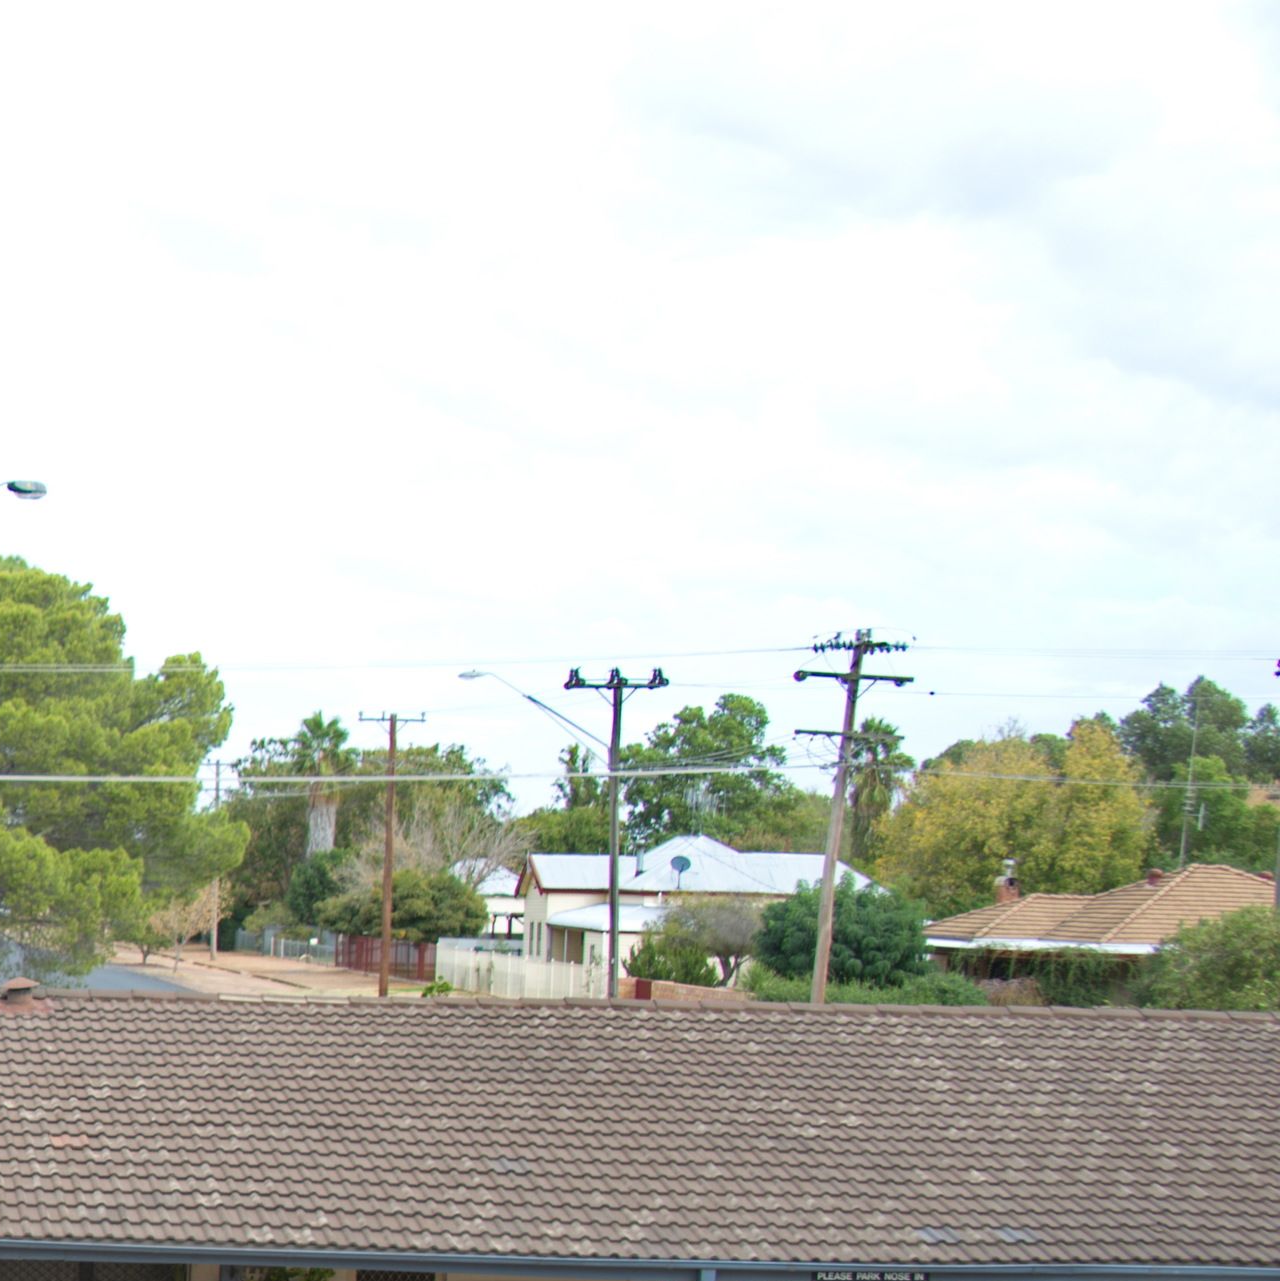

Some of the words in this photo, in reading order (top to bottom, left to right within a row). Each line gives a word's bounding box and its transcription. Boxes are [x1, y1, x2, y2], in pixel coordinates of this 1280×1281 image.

[816, 1272, 853, 1281] PLEASE
[856, 1272, 881, 1281] PARK
[884, 1272, 911, 1281] NOSE
[914, 1272, 924, 1281] IN
